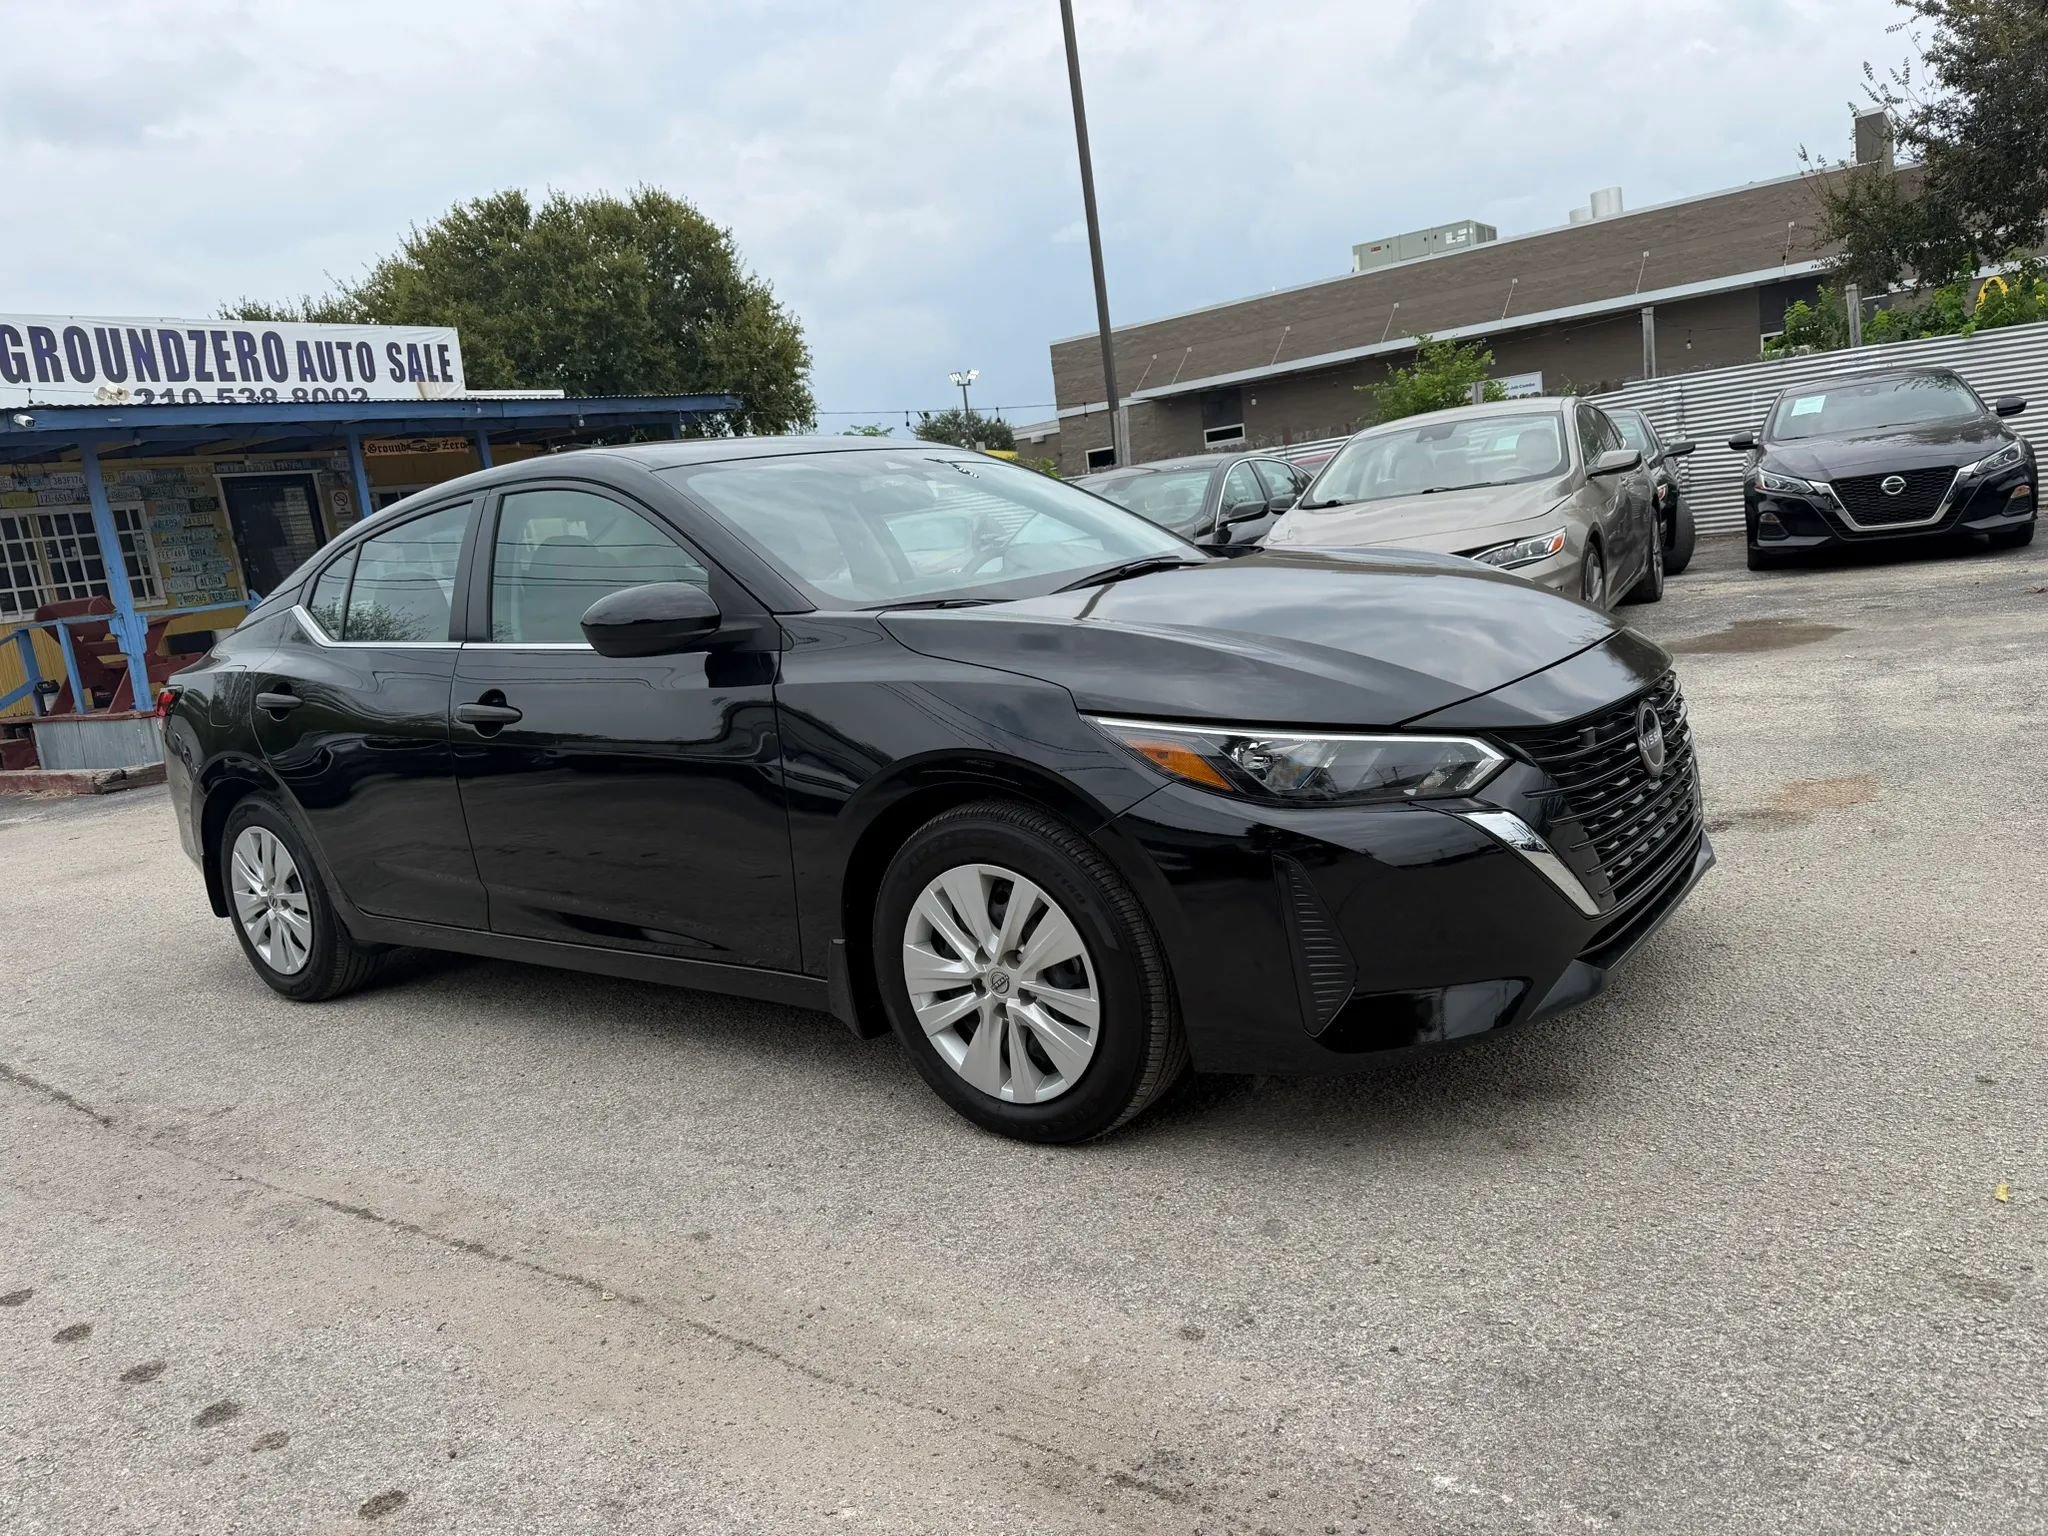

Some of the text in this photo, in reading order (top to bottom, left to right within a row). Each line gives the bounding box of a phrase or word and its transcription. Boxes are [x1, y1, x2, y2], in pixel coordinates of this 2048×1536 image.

[0, 323, 453, 384] GROUNDZERO AUTO SALE
[134, 387, 203, 404] 210
[217, 387, 279, 402] 538
[367, 439, 467, 454] Ground Zero
[1639, 730, 1661, 749] NISS
